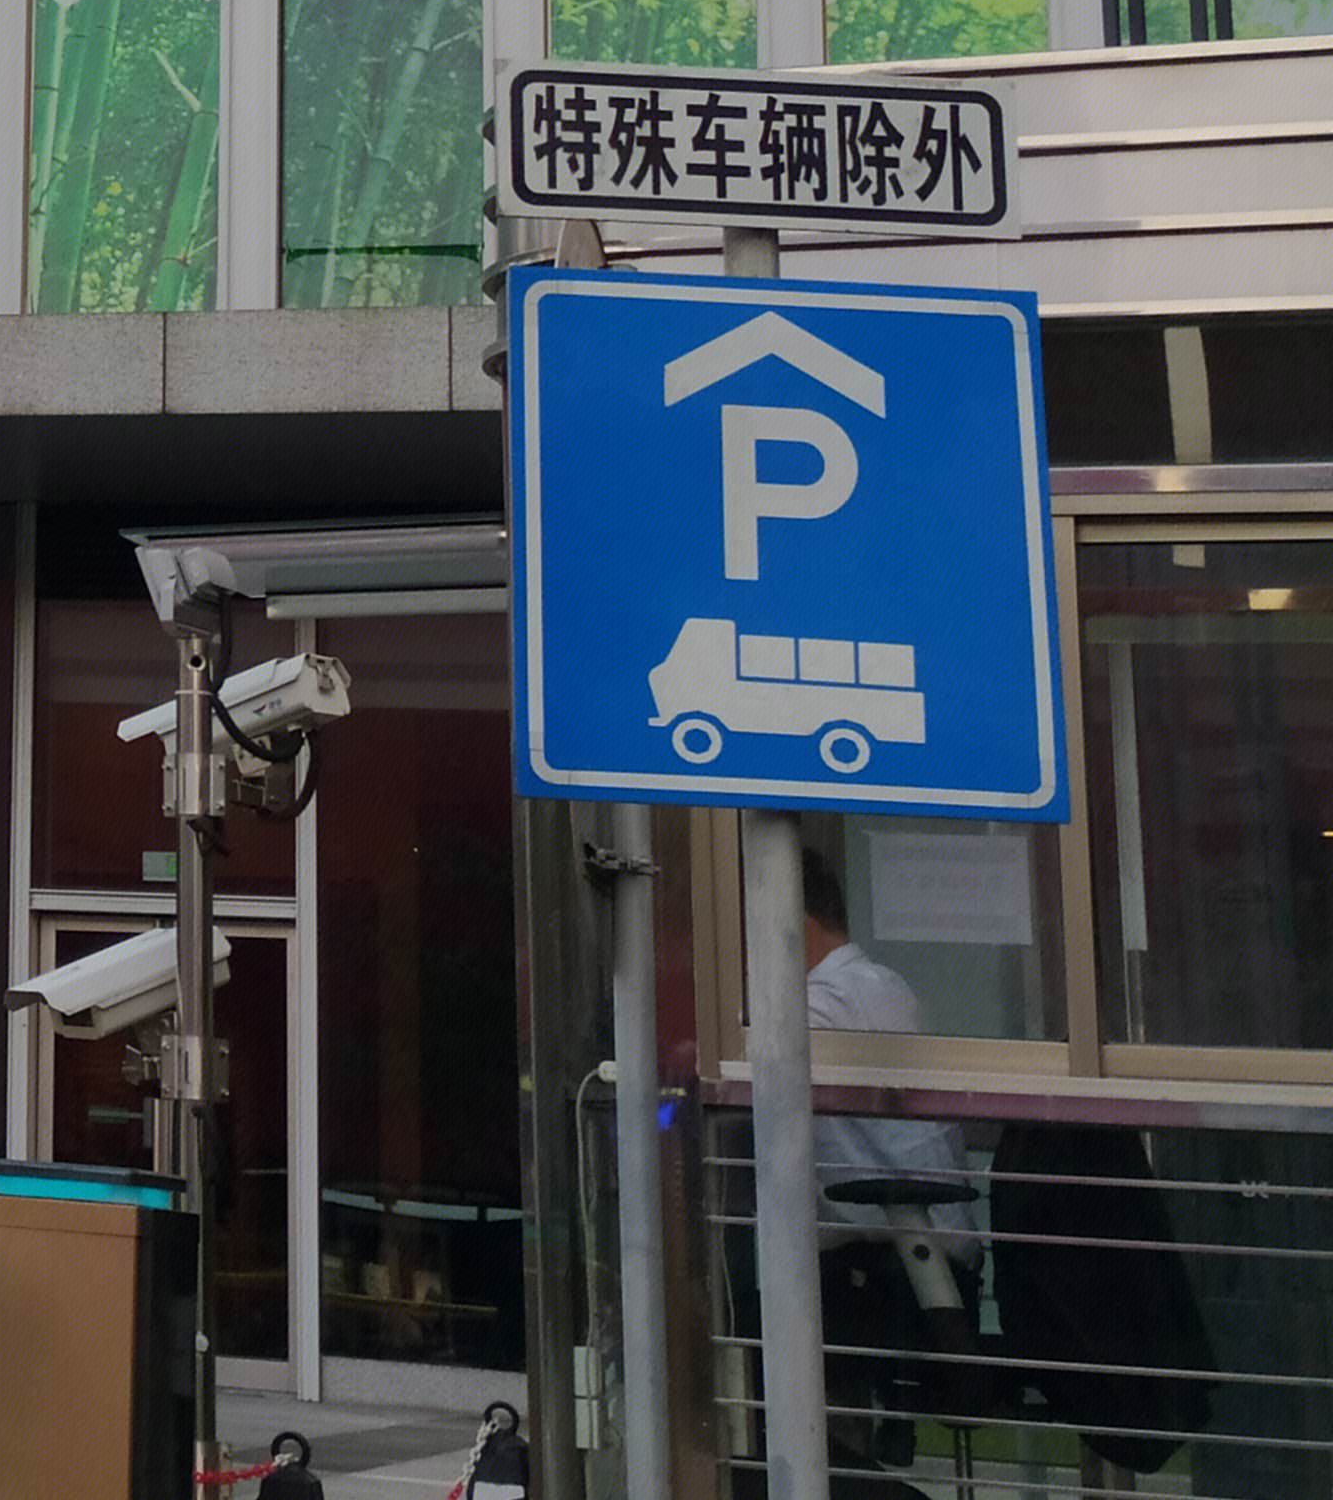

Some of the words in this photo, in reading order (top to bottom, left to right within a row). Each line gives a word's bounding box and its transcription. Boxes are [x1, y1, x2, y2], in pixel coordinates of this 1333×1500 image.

[533, 84, 983, 212] 特殊车辆除外
[720, 404, 859, 581] P
